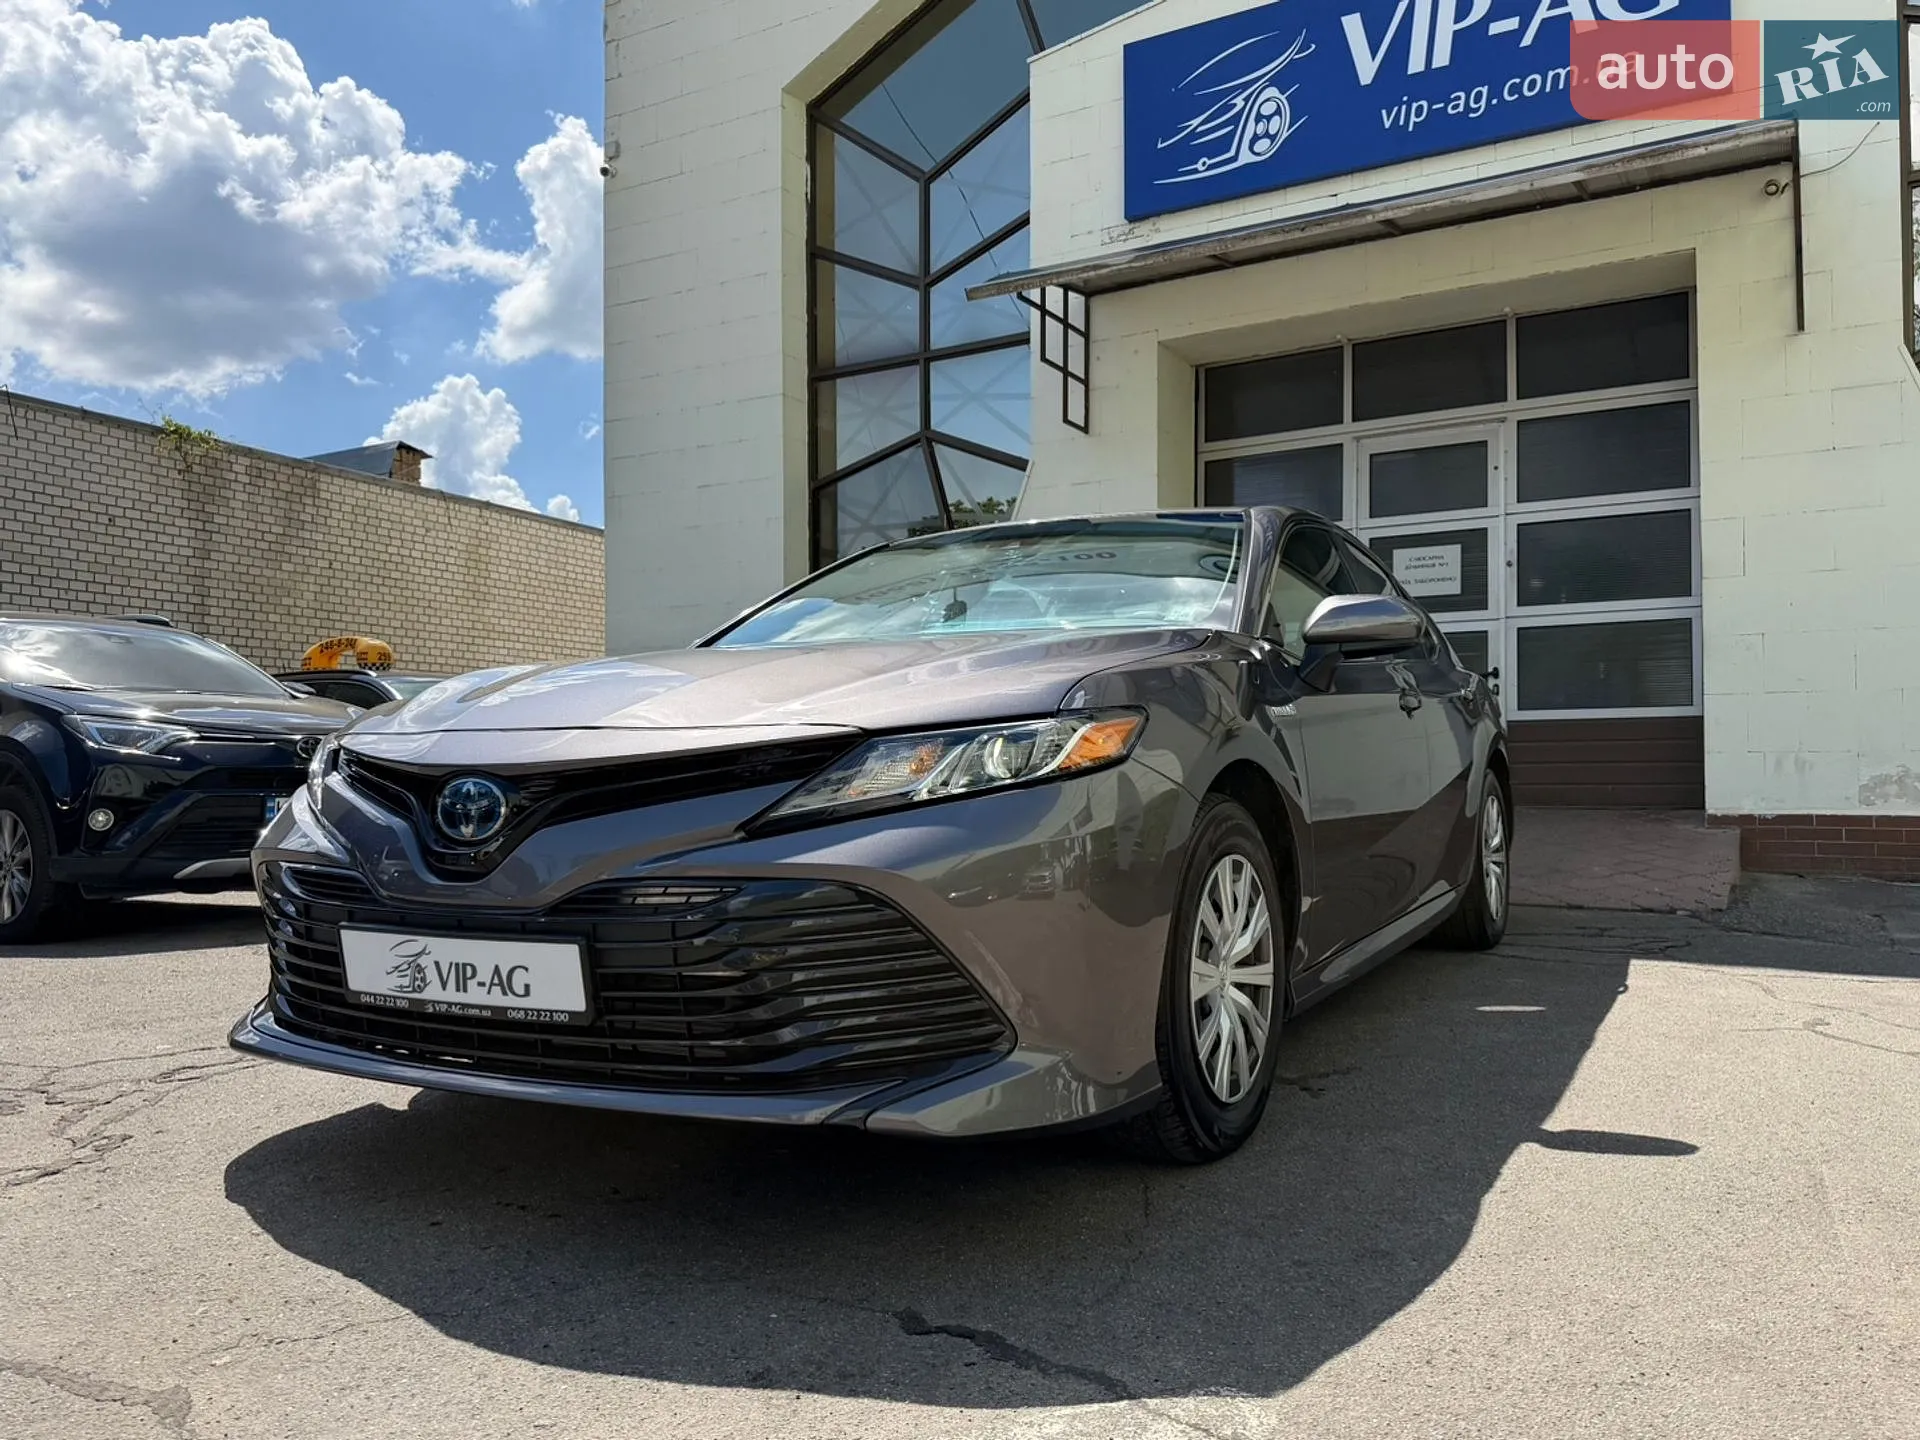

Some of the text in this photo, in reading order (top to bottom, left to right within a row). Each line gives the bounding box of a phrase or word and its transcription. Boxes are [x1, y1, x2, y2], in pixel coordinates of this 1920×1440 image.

[1341, 0, 1679, 86] VIP-A
[433, 960, 531, 998] VIP-AG
[507, 1008, 569, 1022] 068 22 22 100
